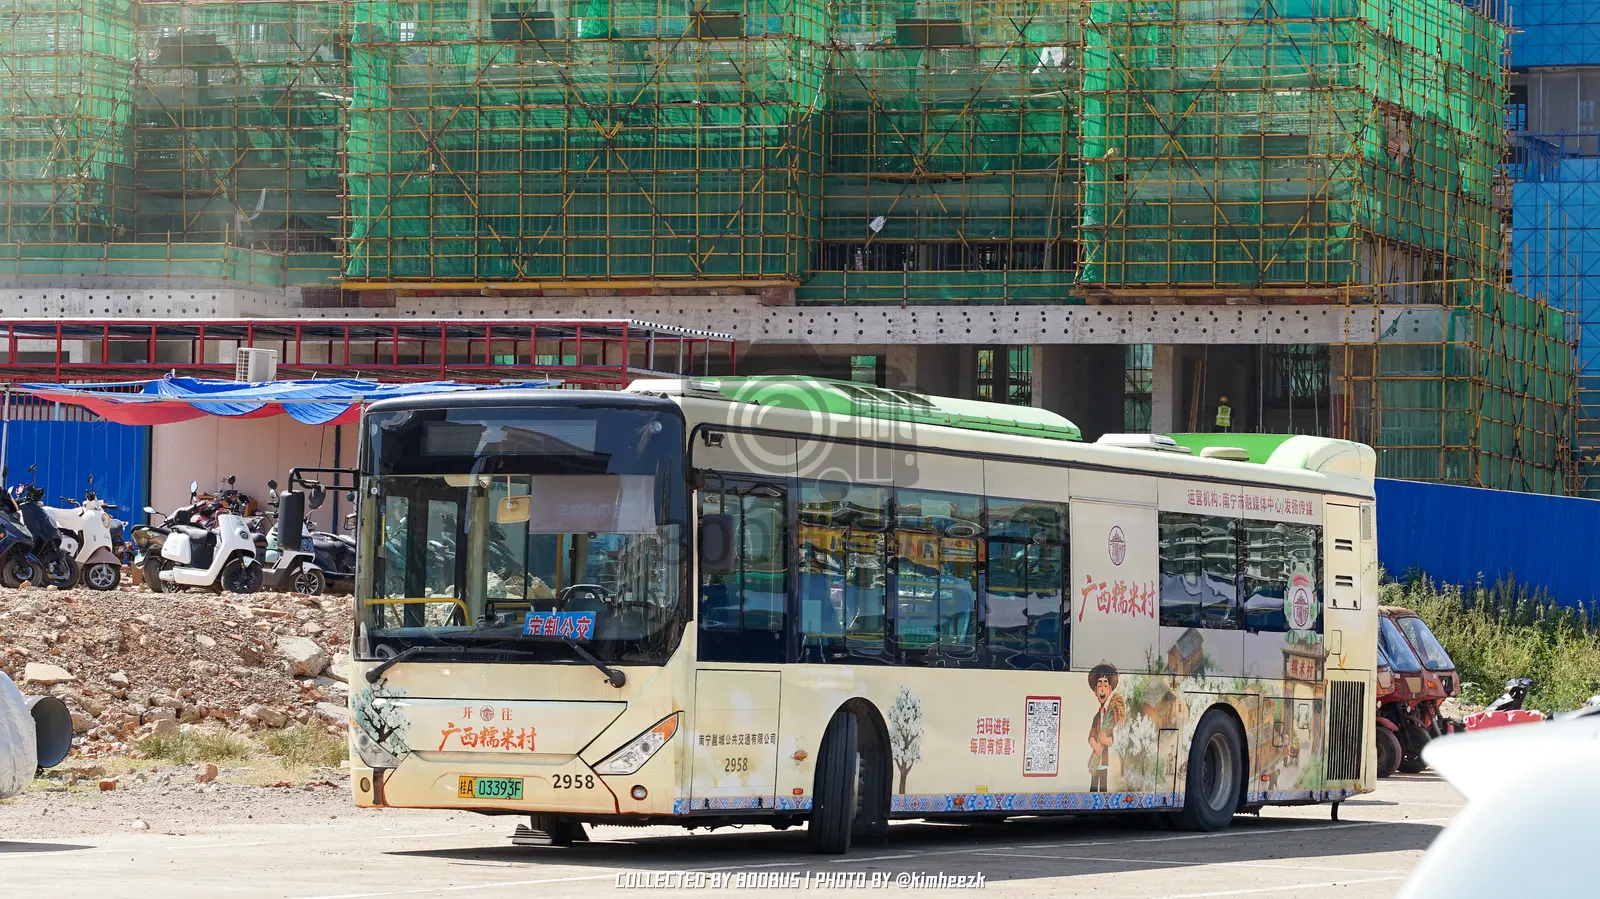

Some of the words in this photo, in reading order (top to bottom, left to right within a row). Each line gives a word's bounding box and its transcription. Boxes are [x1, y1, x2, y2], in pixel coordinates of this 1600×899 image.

[1079, 574, 1155, 622] 广西糯米村
[529, 615, 592, 640] 定制公交
[463, 706, 473, 719] 开
[501, 707, 513, 721] 往
[976, 717, 1010, 735] 扫码进群
[438, 722, 537, 752] 广西糯米村
[725, 757, 748, 772] 2958
[552, 774, 595, 789] 2958
